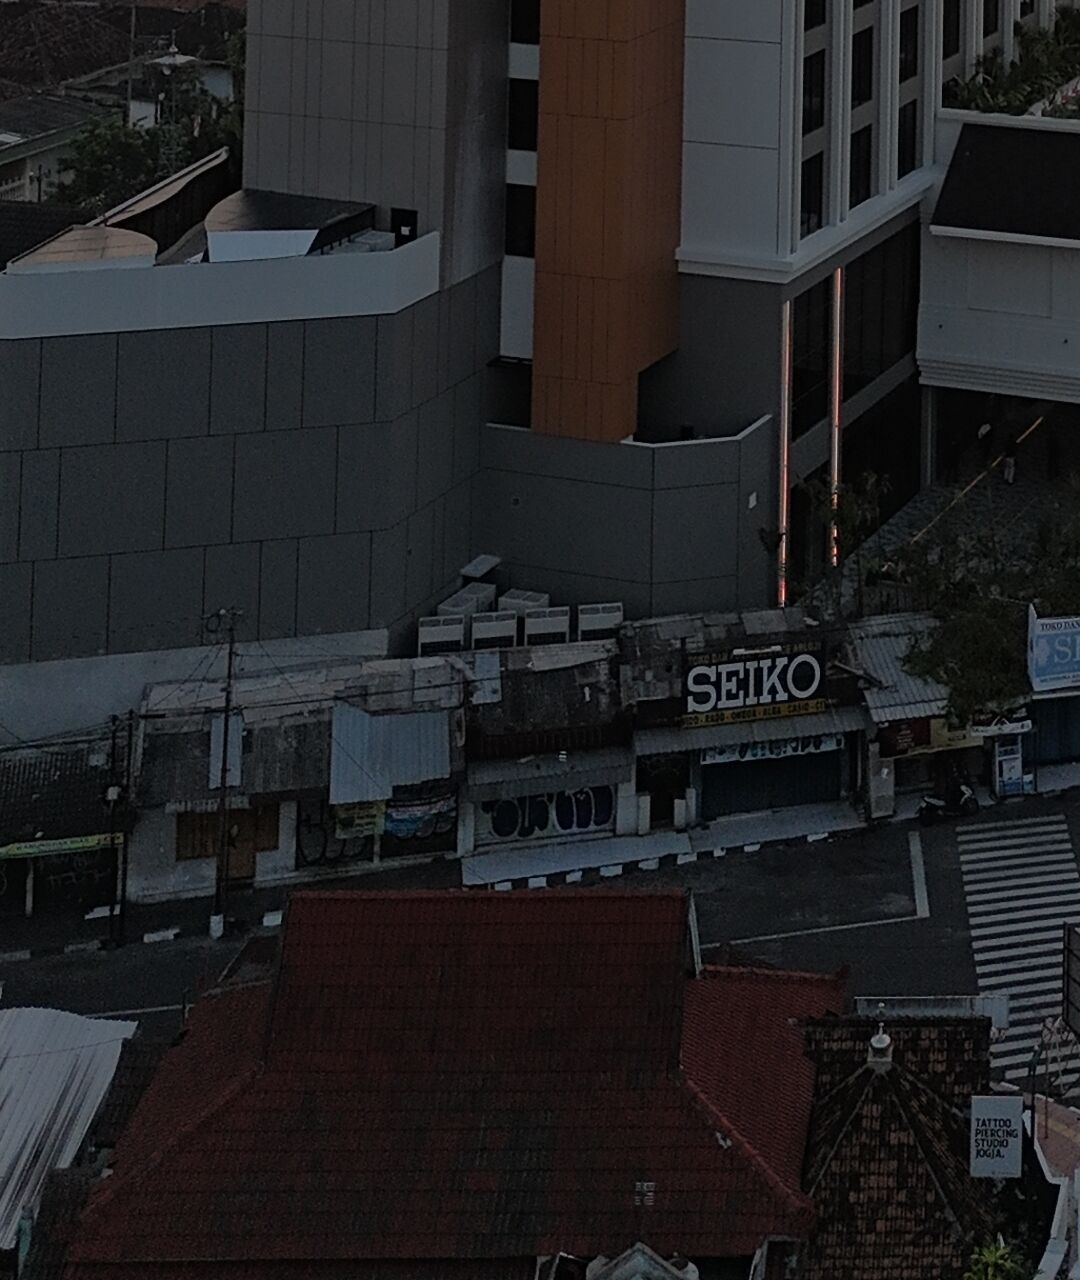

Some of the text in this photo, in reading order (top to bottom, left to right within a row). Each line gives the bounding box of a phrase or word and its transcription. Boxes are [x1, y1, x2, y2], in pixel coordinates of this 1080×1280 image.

[1041, 623, 1062, 632] TOKO
[1063, 620, 1080, 629] DAN
[687, 654, 821, 713] SEIKO
[975, 1118, 1012, 1128] TATTOO
[975, 1128, 1018, 1139] PIERCING
[974, 1138, 1009, 1148] STUDIO
